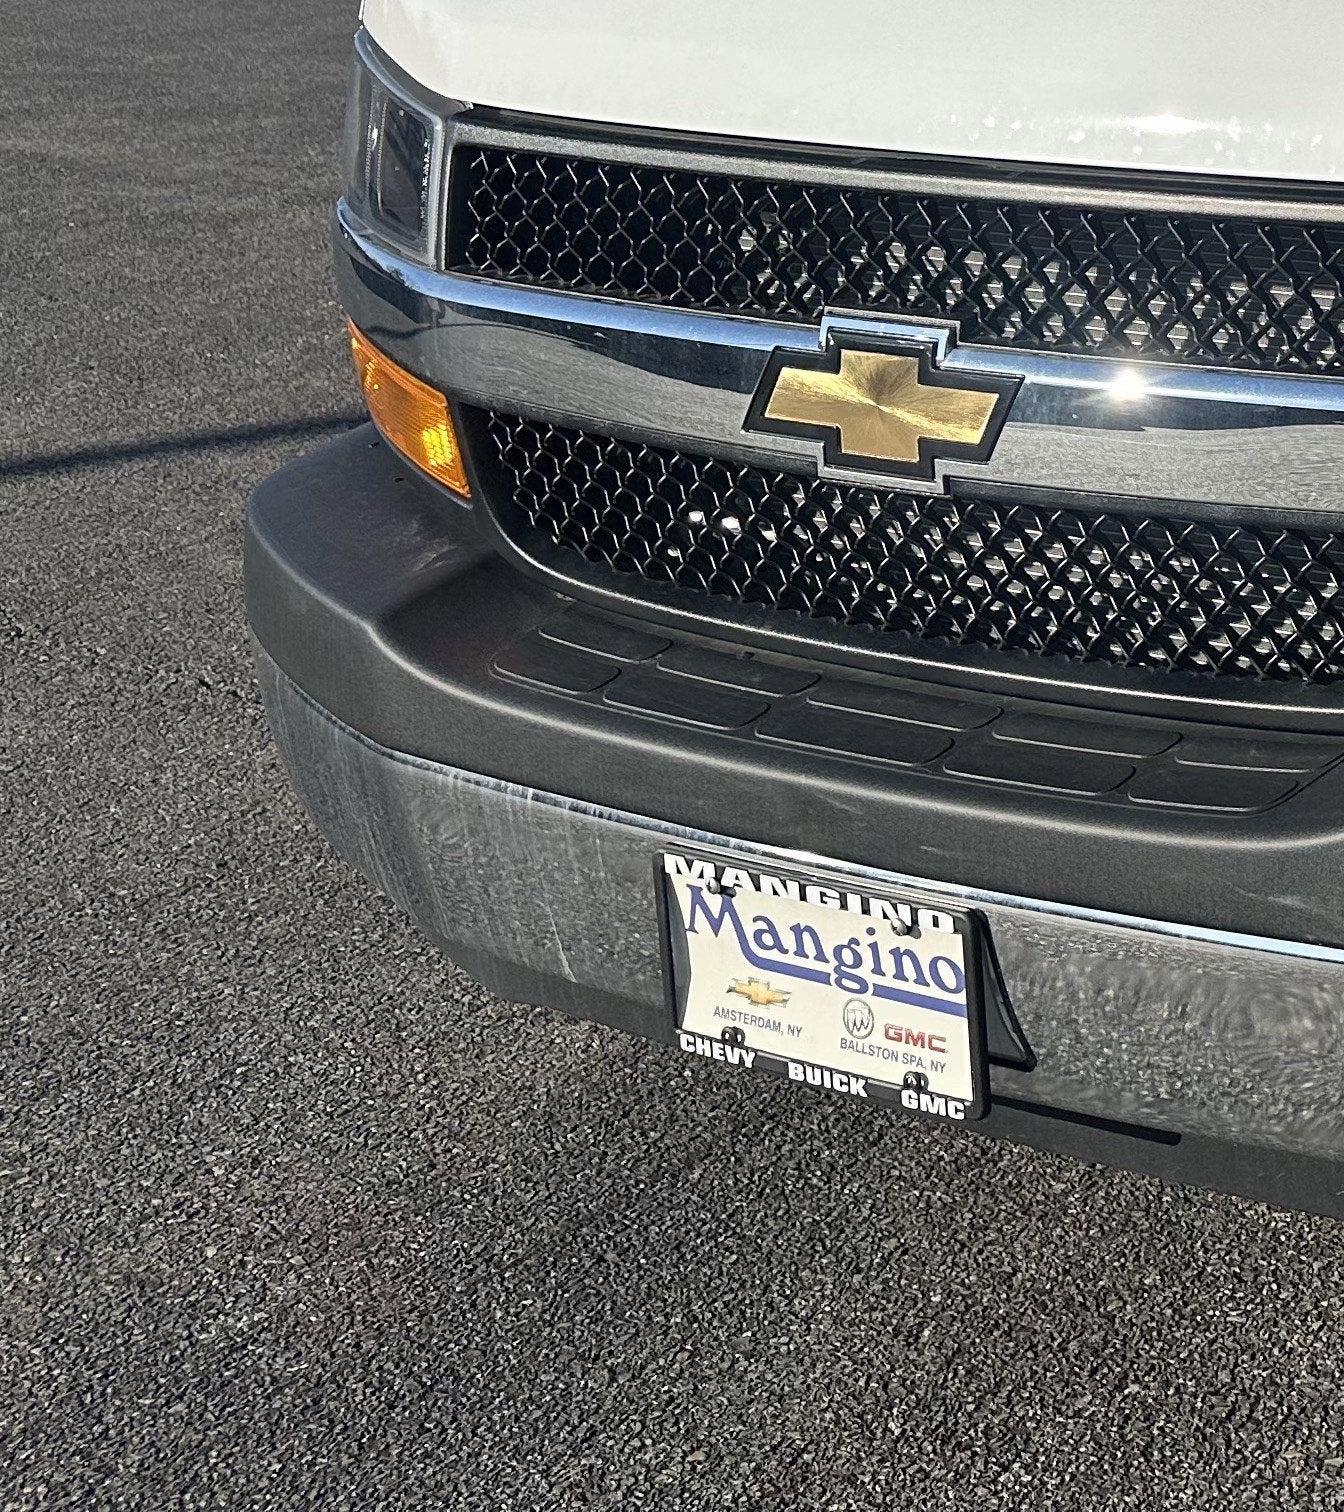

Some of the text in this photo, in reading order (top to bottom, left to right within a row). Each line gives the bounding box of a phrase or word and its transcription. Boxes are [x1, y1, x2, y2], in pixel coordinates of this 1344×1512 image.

[663, 853, 955, 935] MANGINO
[685, 884, 967, 998] Mangino
[713, 1005, 803, 1038] AMSTERDAM, NY
[883, 1023, 949, 1054] GMC
[679, 1033, 756, 1069] CHEVY
[839, 1037, 947, 1075] BALLSTON SPA, NY
[787, 1061, 869, 1099] BUICK
[901, 1088, 966, 1121] GMC
